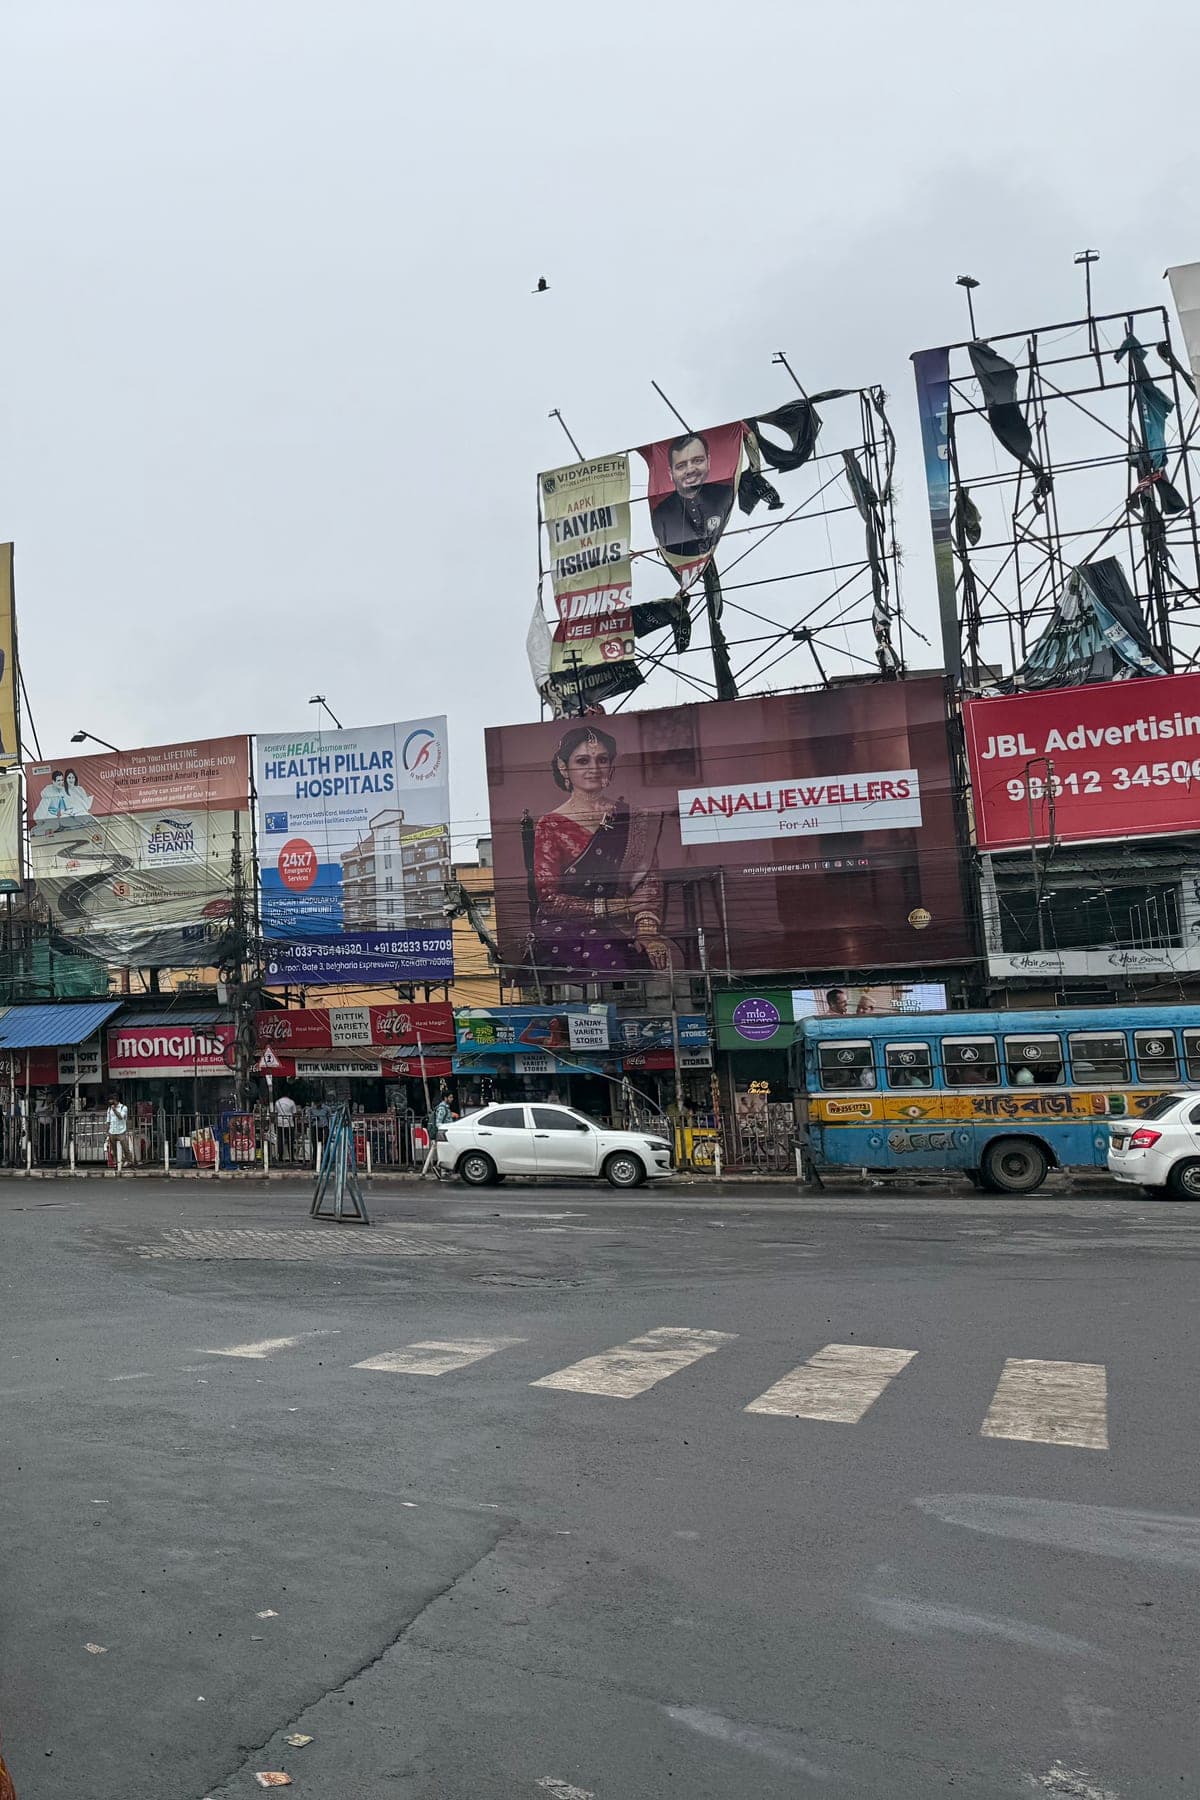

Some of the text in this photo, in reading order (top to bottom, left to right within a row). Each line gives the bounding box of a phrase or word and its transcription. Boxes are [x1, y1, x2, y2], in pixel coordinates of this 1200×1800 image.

[557, 461, 625, 483] VIDYAPEETH
[567, 496, 594, 513] AAPKI
[580, 537, 593, 548] KA
[567, 624, 593, 637] JEE
[287, 742, 316, 756] HEAL
[980, 734, 1036, 760] JBL
[164, 749, 198, 760] LIFETIME
[100, 755, 236, 780] GUARANTEED MONTHLY INCOME NOW
[264, 750, 393, 780] HEALTH PILLAR
[142, 774, 173, 784] Enhanced
[174, 771, 199, 781] Annuity
[201, 769, 219, 777] Rates
[296, 773, 394, 799] HOSPITALS
[688, 779, 911, 818] ANJALI JEWELLERS
[779, 818, 819, 831] For All
[148, 830, 193, 843] JEEVAN
[148, 841, 194, 854] SHANTI
[282, 852, 312, 867] 24x7
[284, 867, 311, 875] Emergency
[743, 861, 810, 875] anjalijewellers.in
[119, 885, 125, 894] 5
[423, 939, 453, 951] 52709
[1020, 955, 1039, 968] Hair
[1119, 953, 1137, 967] Hair
[302, 963, 318, 972] Gate
[335, 1013, 364, 1021] RITTIK
[746, 1008, 766, 1018] mio
[333, 1022, 369, 1031] VARIETY
[334, 1032, 369, 1041] STORES
[118, 1033, 225, 1060] monginis
[297, 1063, 379, 1073] RITTIK VARIETY STORES
